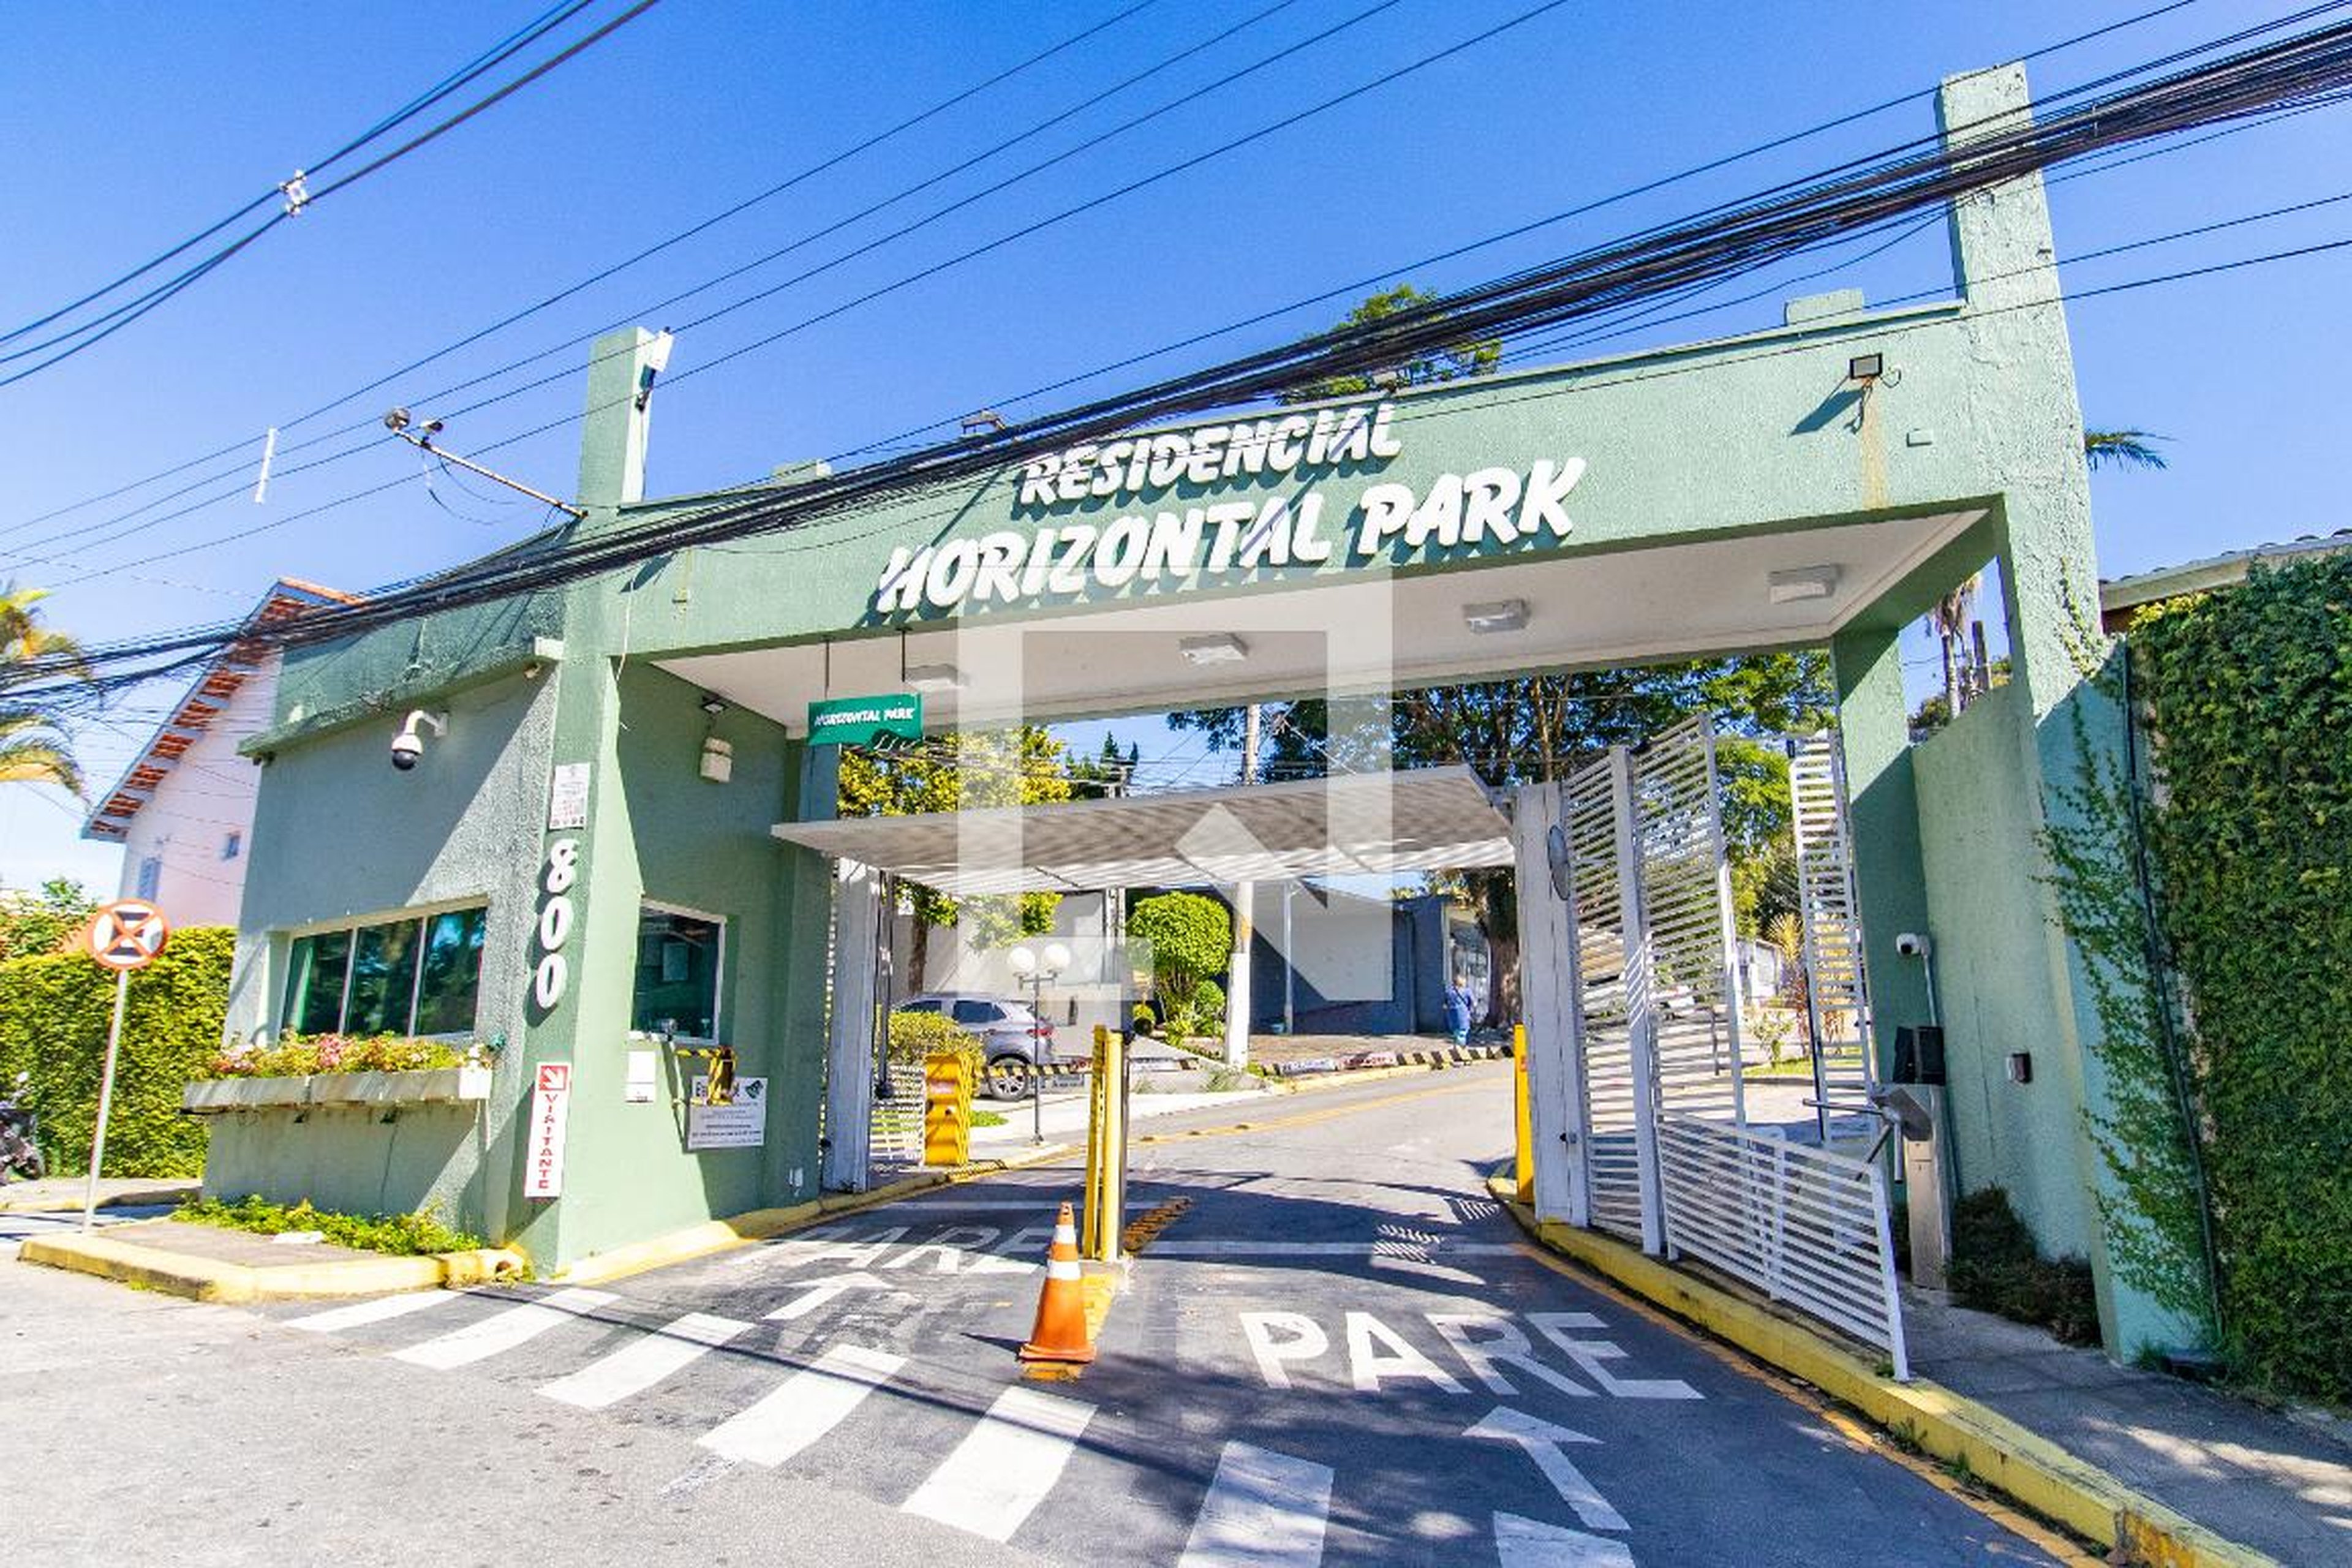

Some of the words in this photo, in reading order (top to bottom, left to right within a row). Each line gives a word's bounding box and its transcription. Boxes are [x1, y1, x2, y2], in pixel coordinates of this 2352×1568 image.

[1020, 403, 1401, 505] RESIDENCIAL
[876, 494, 1332, 612] HORIZONTAL
[1357, 458, 1585, 555] PARK
[815, 710, 880, 726] HORIZONTAL
[884, 707, 915, 720] PARK
[536, 839, 578, 1008] 800
[729, 1223, 1056, 1275] PARE
[1238, 1312, 1707, 1400] PARE
